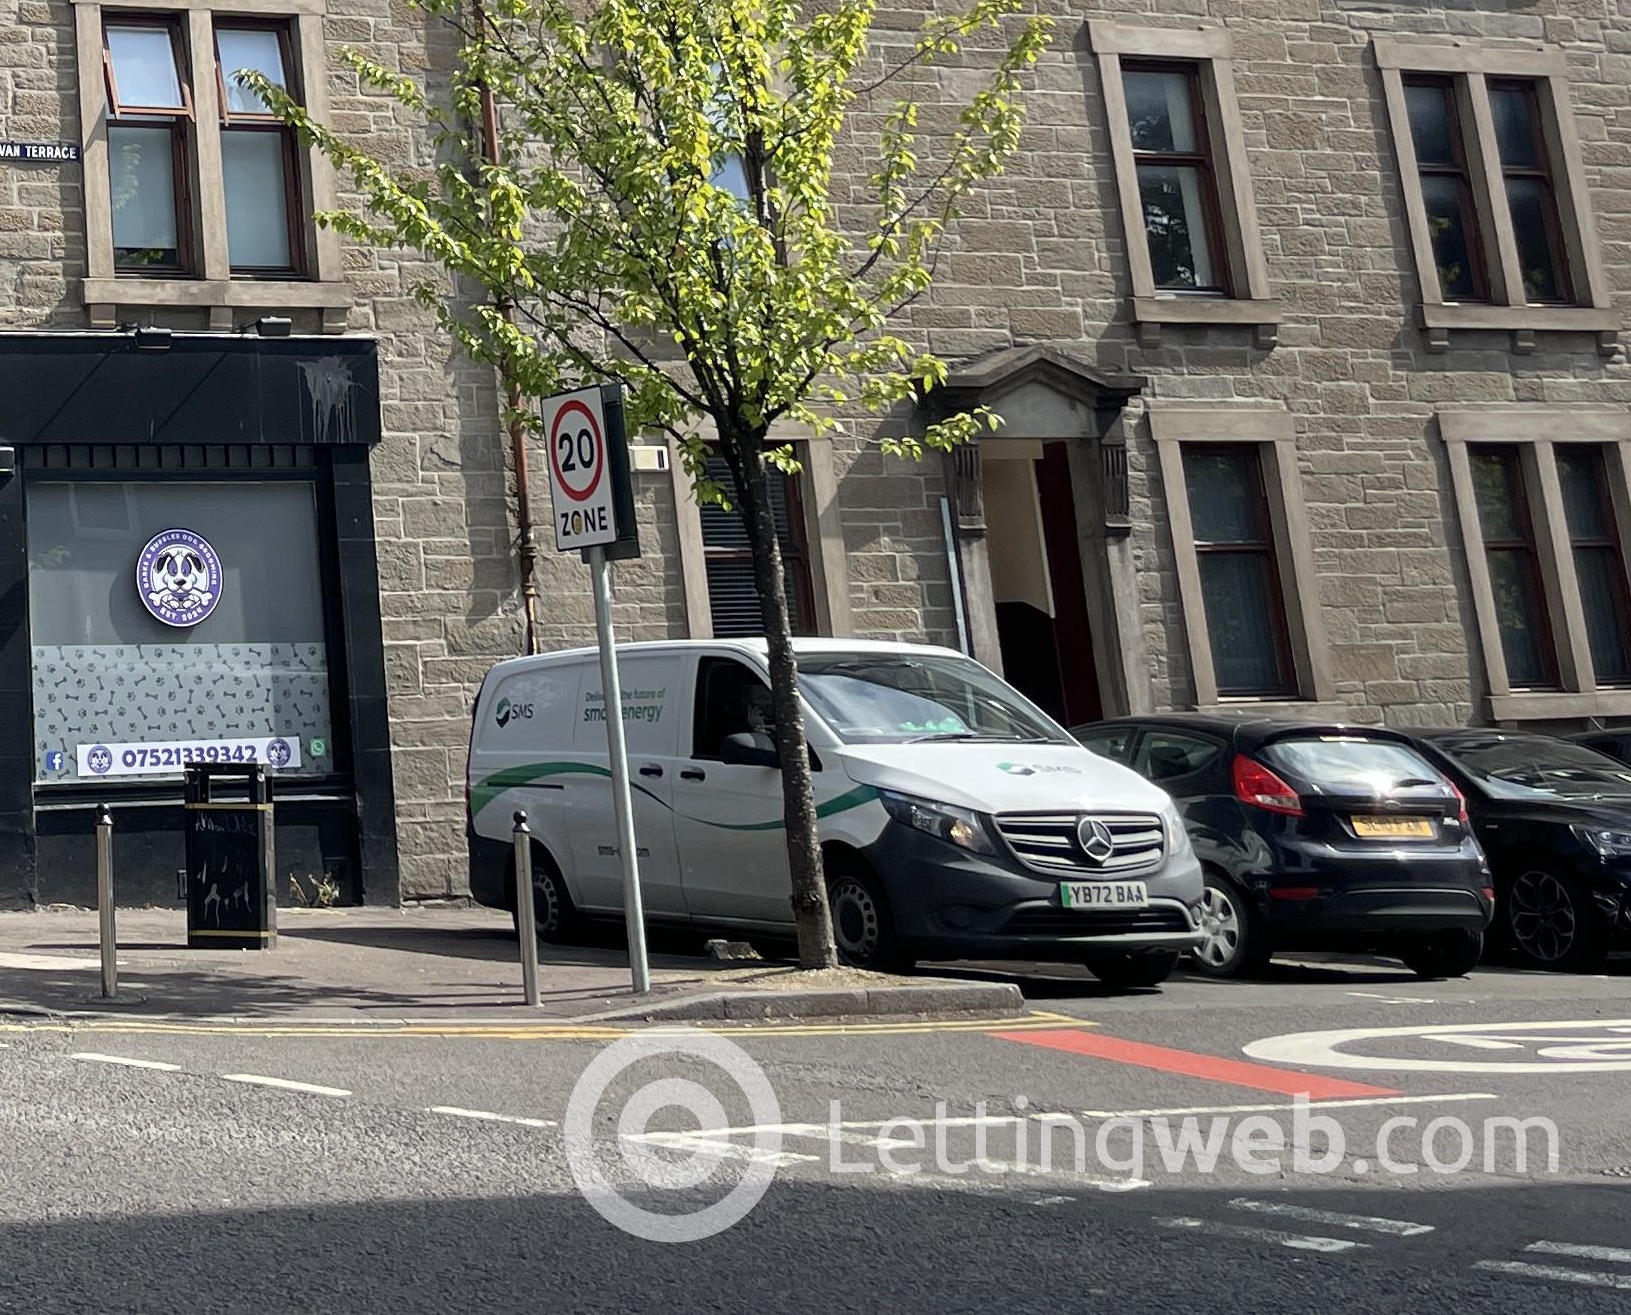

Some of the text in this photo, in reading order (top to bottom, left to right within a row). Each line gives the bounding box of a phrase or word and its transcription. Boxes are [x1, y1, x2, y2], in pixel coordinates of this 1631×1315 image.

[25, 145, 77, 159] TERRACE
[558, 428, 595, 473] 20
[560, 505, 608, 537] ZONE
[511, 703, 535, 720] SMS
[621, 704, 664, 723] energy
[121, 745, 258, 768] 07521339342
[1071, 886, 1113, 903] YB72
